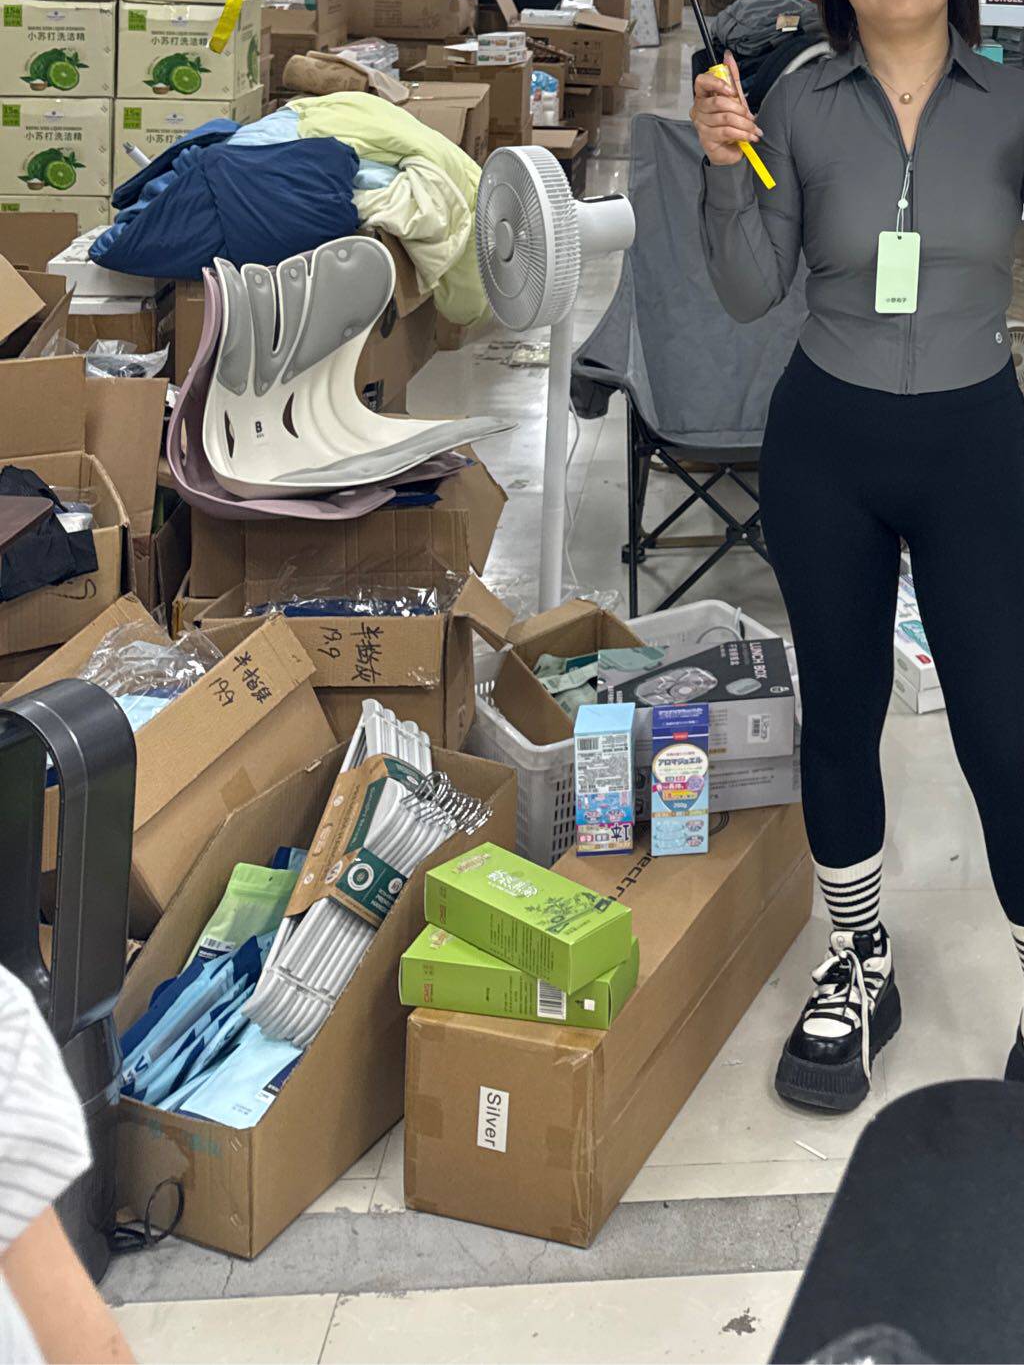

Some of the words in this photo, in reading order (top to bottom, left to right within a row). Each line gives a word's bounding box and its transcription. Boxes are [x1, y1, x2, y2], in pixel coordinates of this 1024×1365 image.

[28, 32, 86, 42] 小苏打洗洁精
[151, 36, 208, 46] 小苏打洗洁精
[25, 131, 83, 142] 小苏打洗洁精
[317, 626, 343, 659] 19.9
[750, 641, 766, 665] LUNCH
[753, 663, 768, 680] BOX
[485, 1091, 502, 1148] Silver
